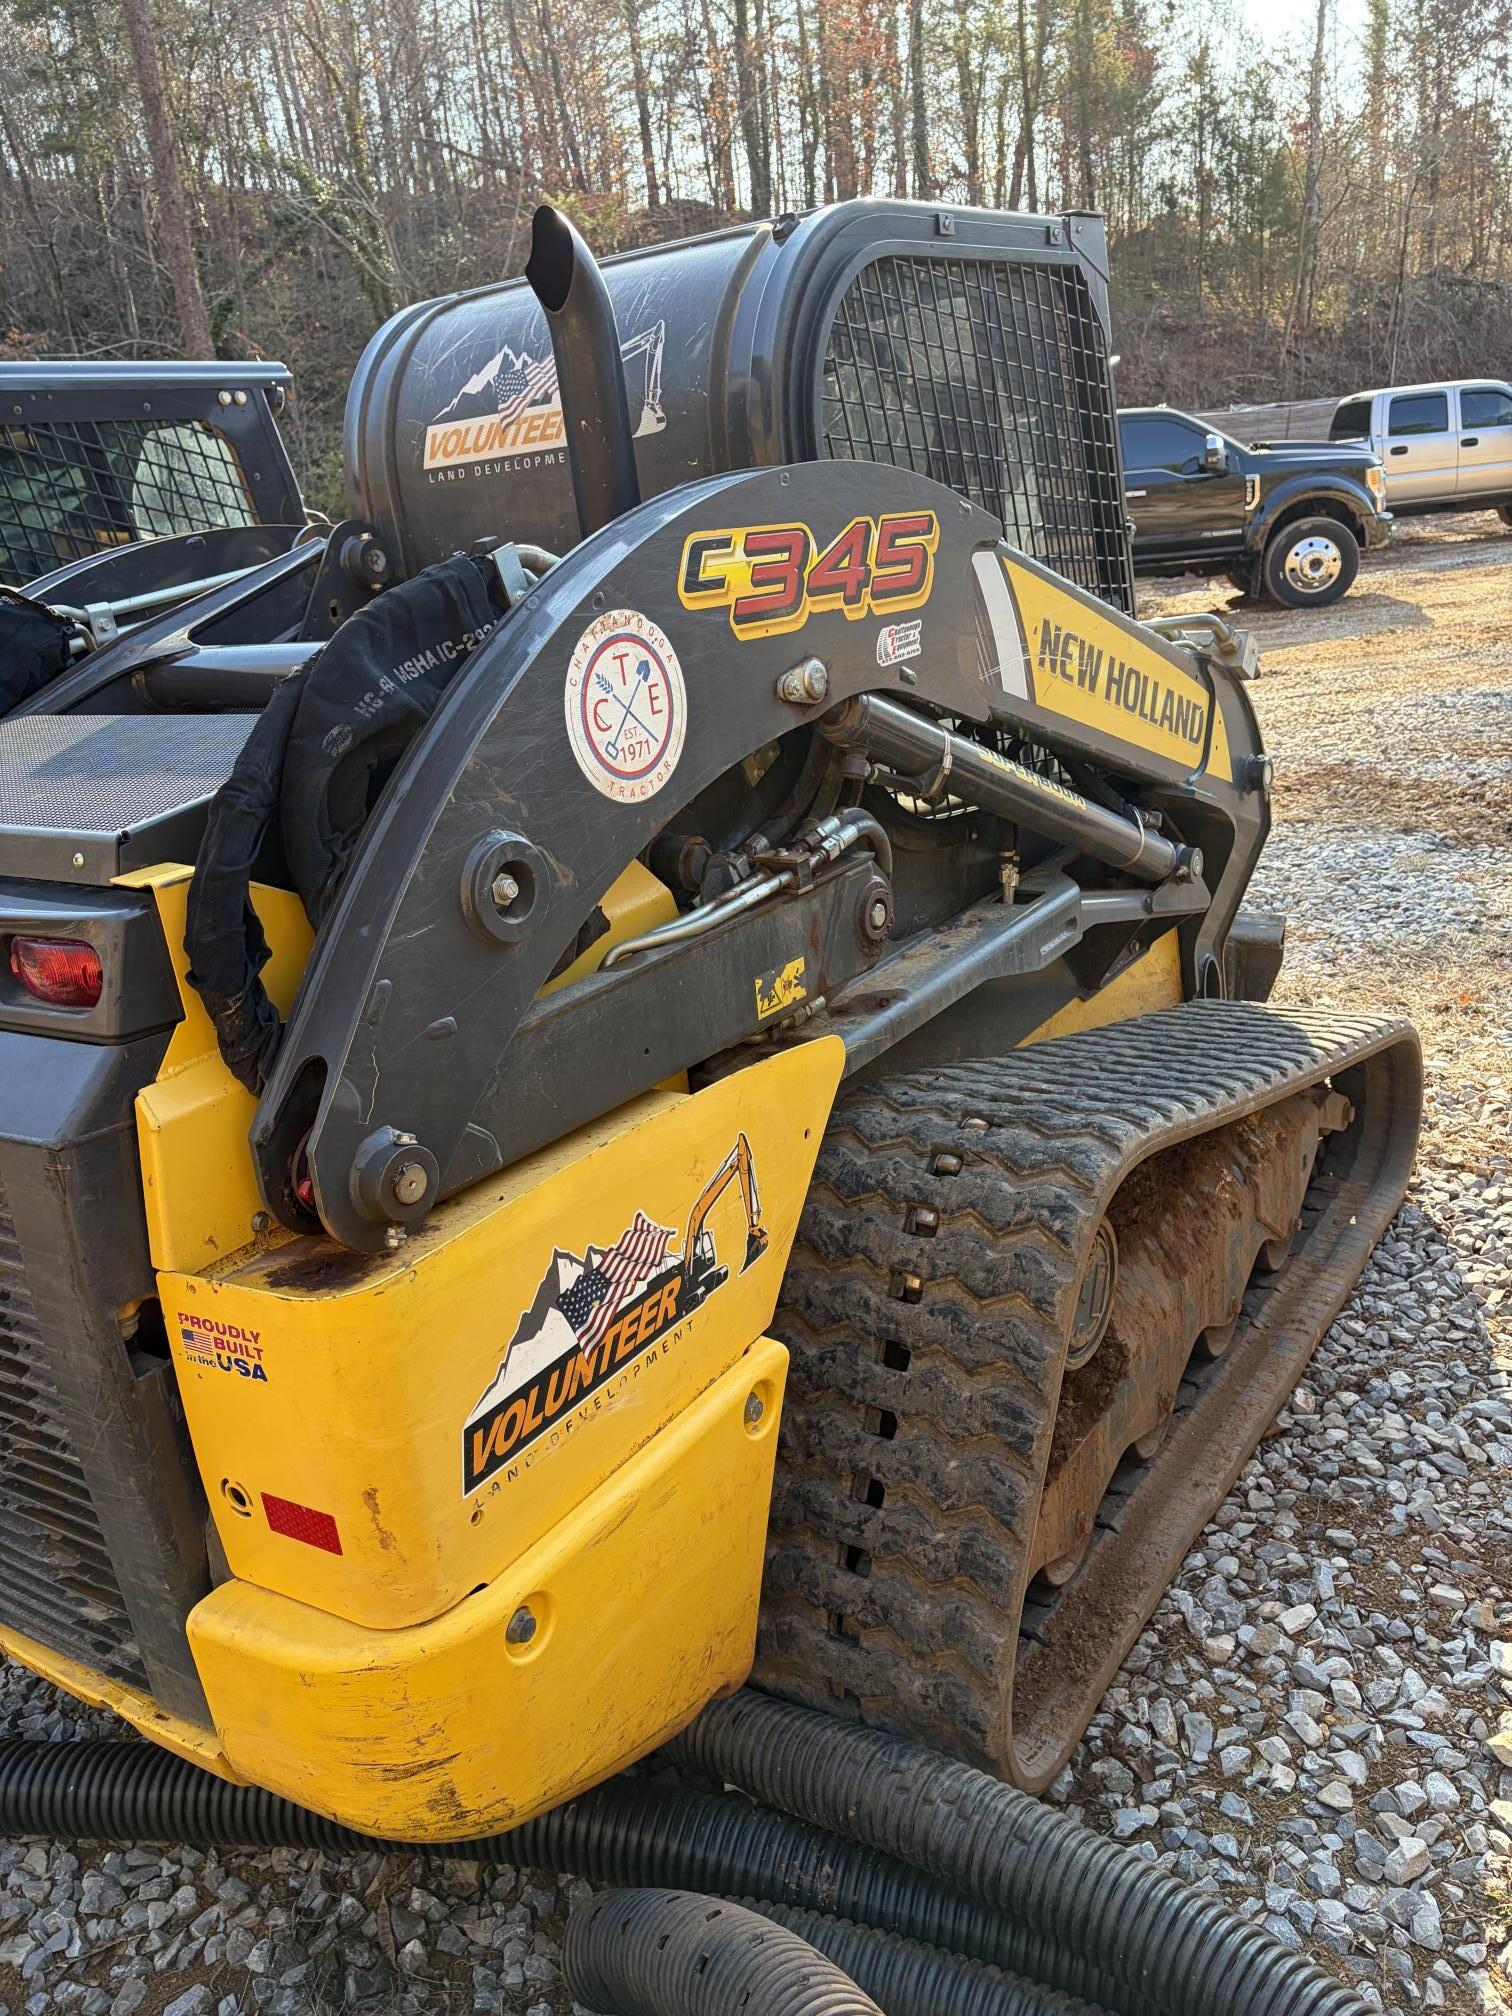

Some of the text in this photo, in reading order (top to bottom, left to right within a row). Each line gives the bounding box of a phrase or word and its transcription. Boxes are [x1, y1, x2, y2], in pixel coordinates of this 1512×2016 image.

[429, 452, 566, 484] LAND DEVELOPME
[569, 613, 673, 687] CHATTANOOGA
[1037, 618, 1204, 745] NEW HOLLAND
[624, 725, 641, 740] EST.
[619, 738, 651, 763] 1971
[608, 760, 672, 798] TRACTOR
[178, 1312, 260, 1344] PROUDLY
[213, 1336, 263, 1361] BUILT
[216, 1352, 268, 1382] USA
[473, 1276, 682, 1477] VOLUNTEER
